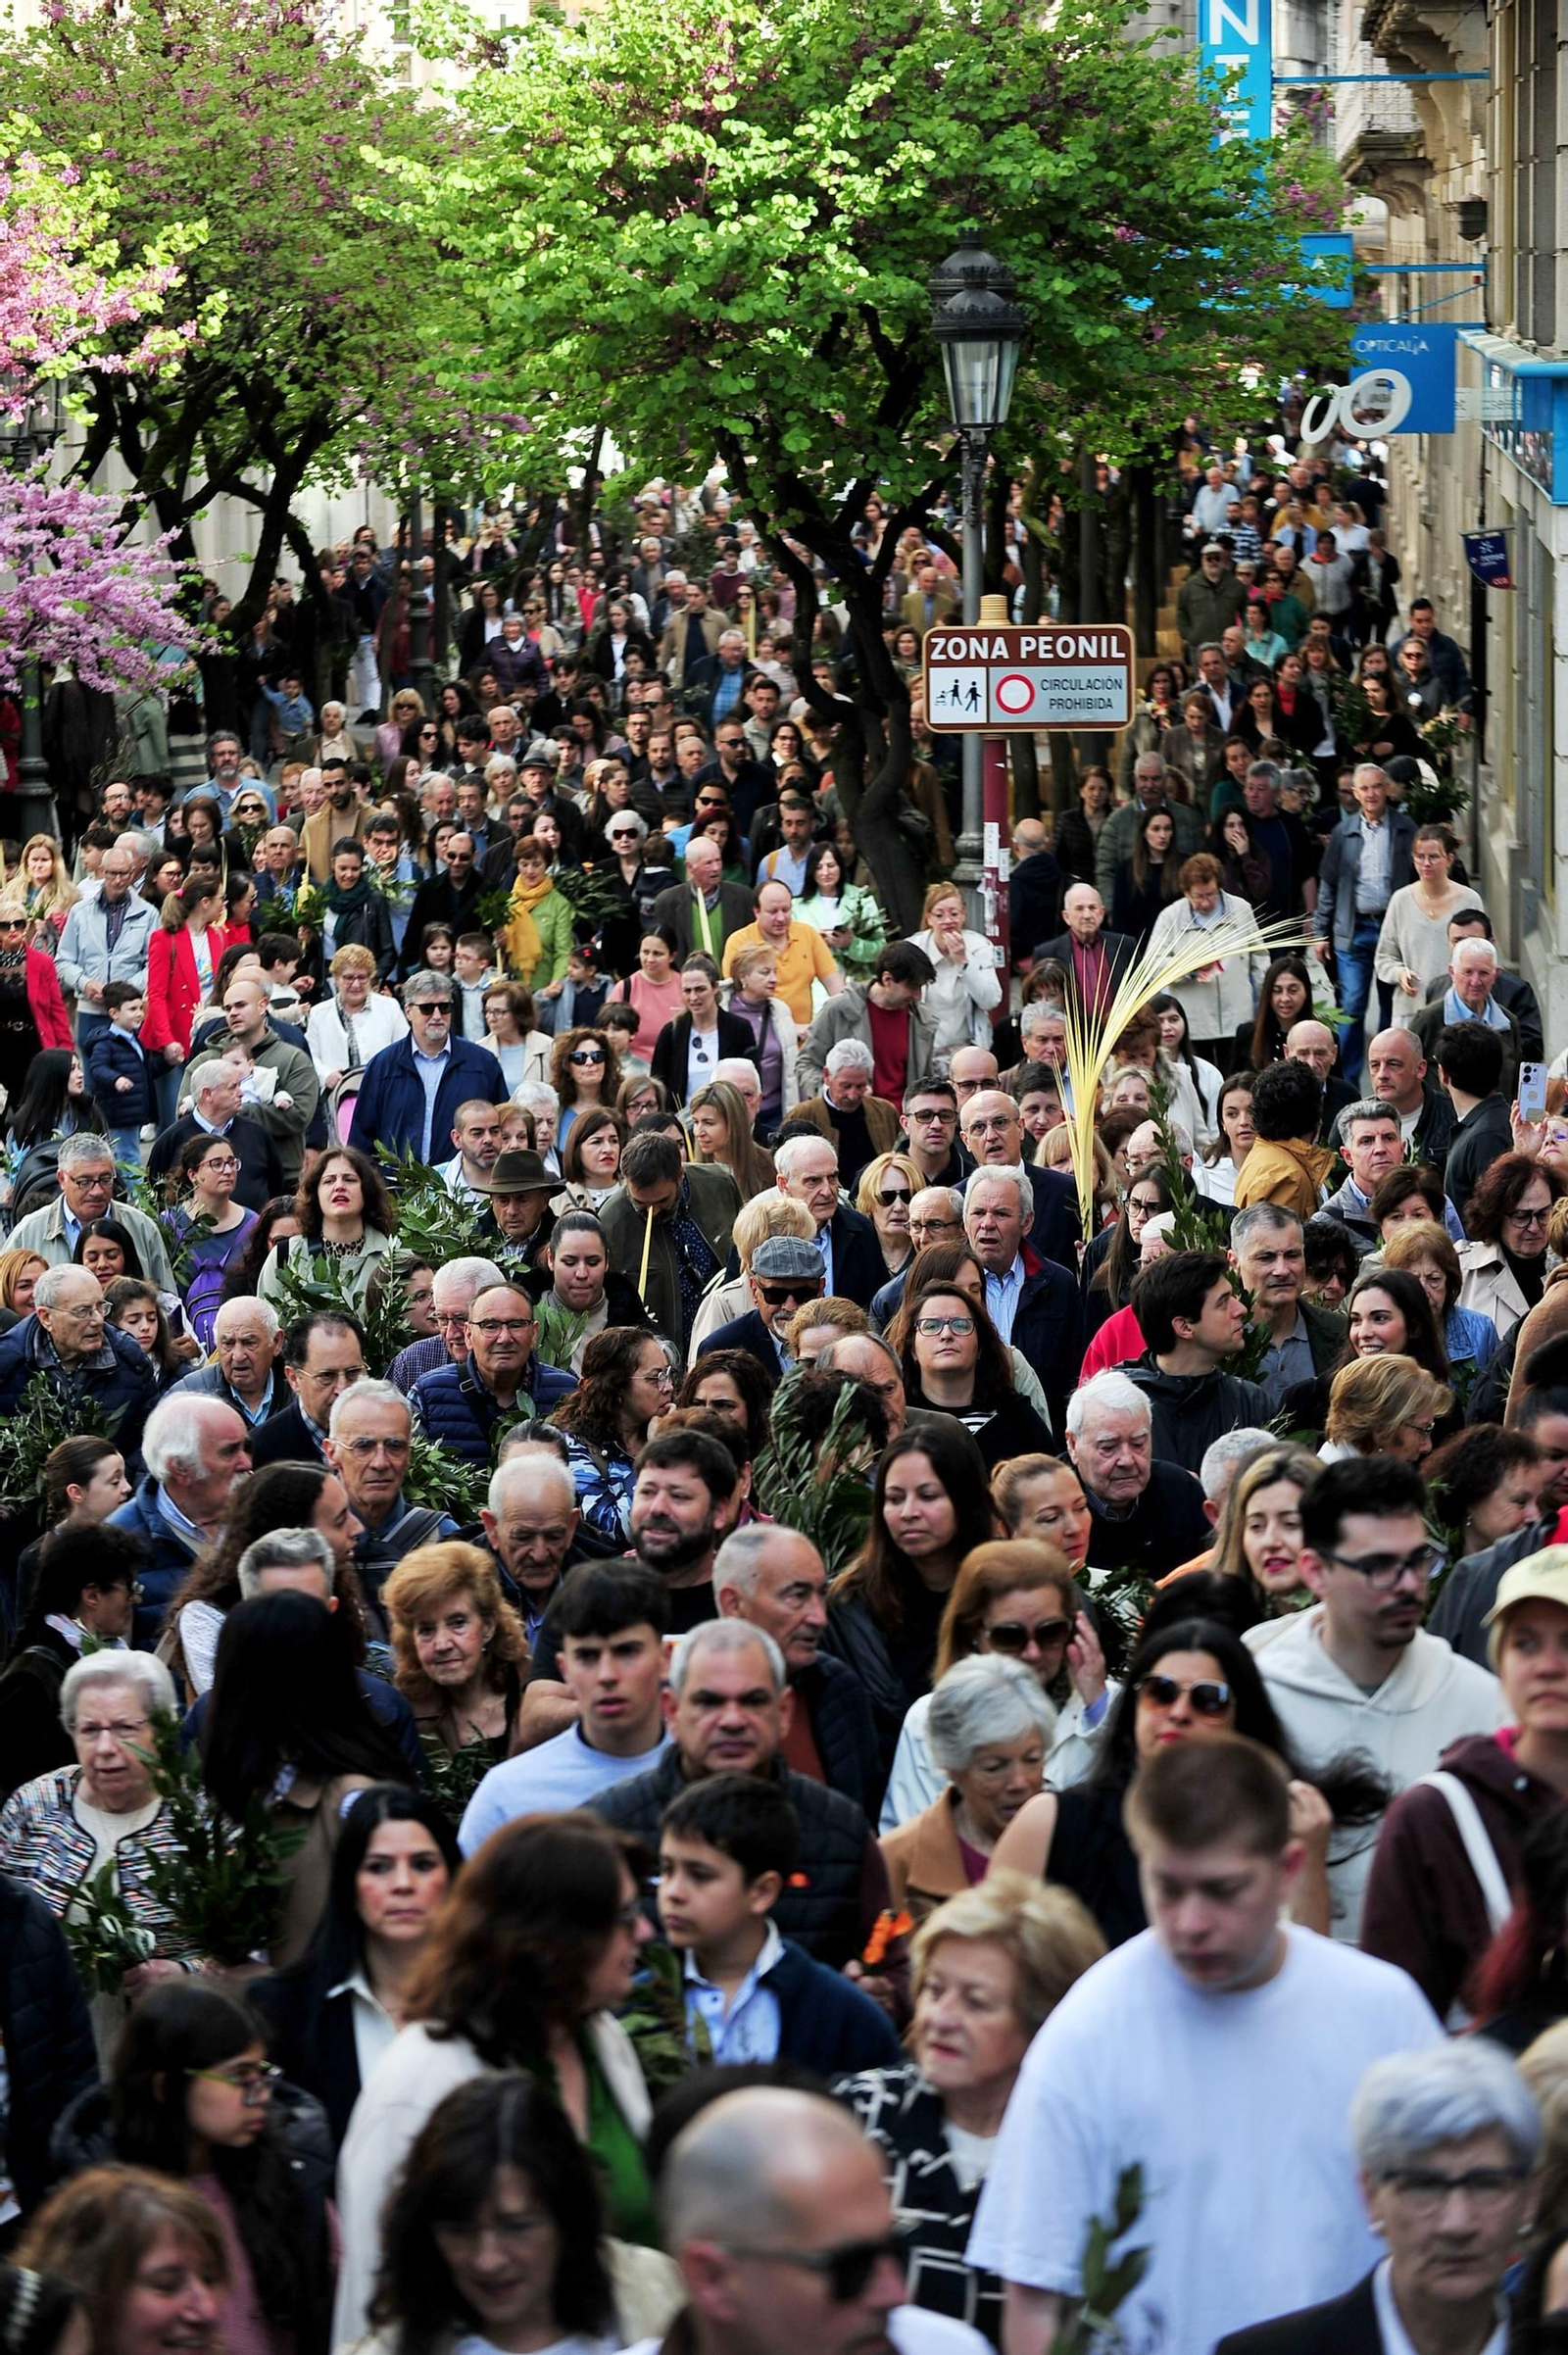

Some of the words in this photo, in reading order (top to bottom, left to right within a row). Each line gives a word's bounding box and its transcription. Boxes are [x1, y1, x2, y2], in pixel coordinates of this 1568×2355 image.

[1355, 335, 1430, 355] OPTICALIA
[930, 637, 1009, 661] ZONA
[1020, 636, 1126, 659] PEONIL
[1041, 675, 1123, 691] CIRCULACIÓN
[1049, 698, 1114, 710] PROHIBIDA
